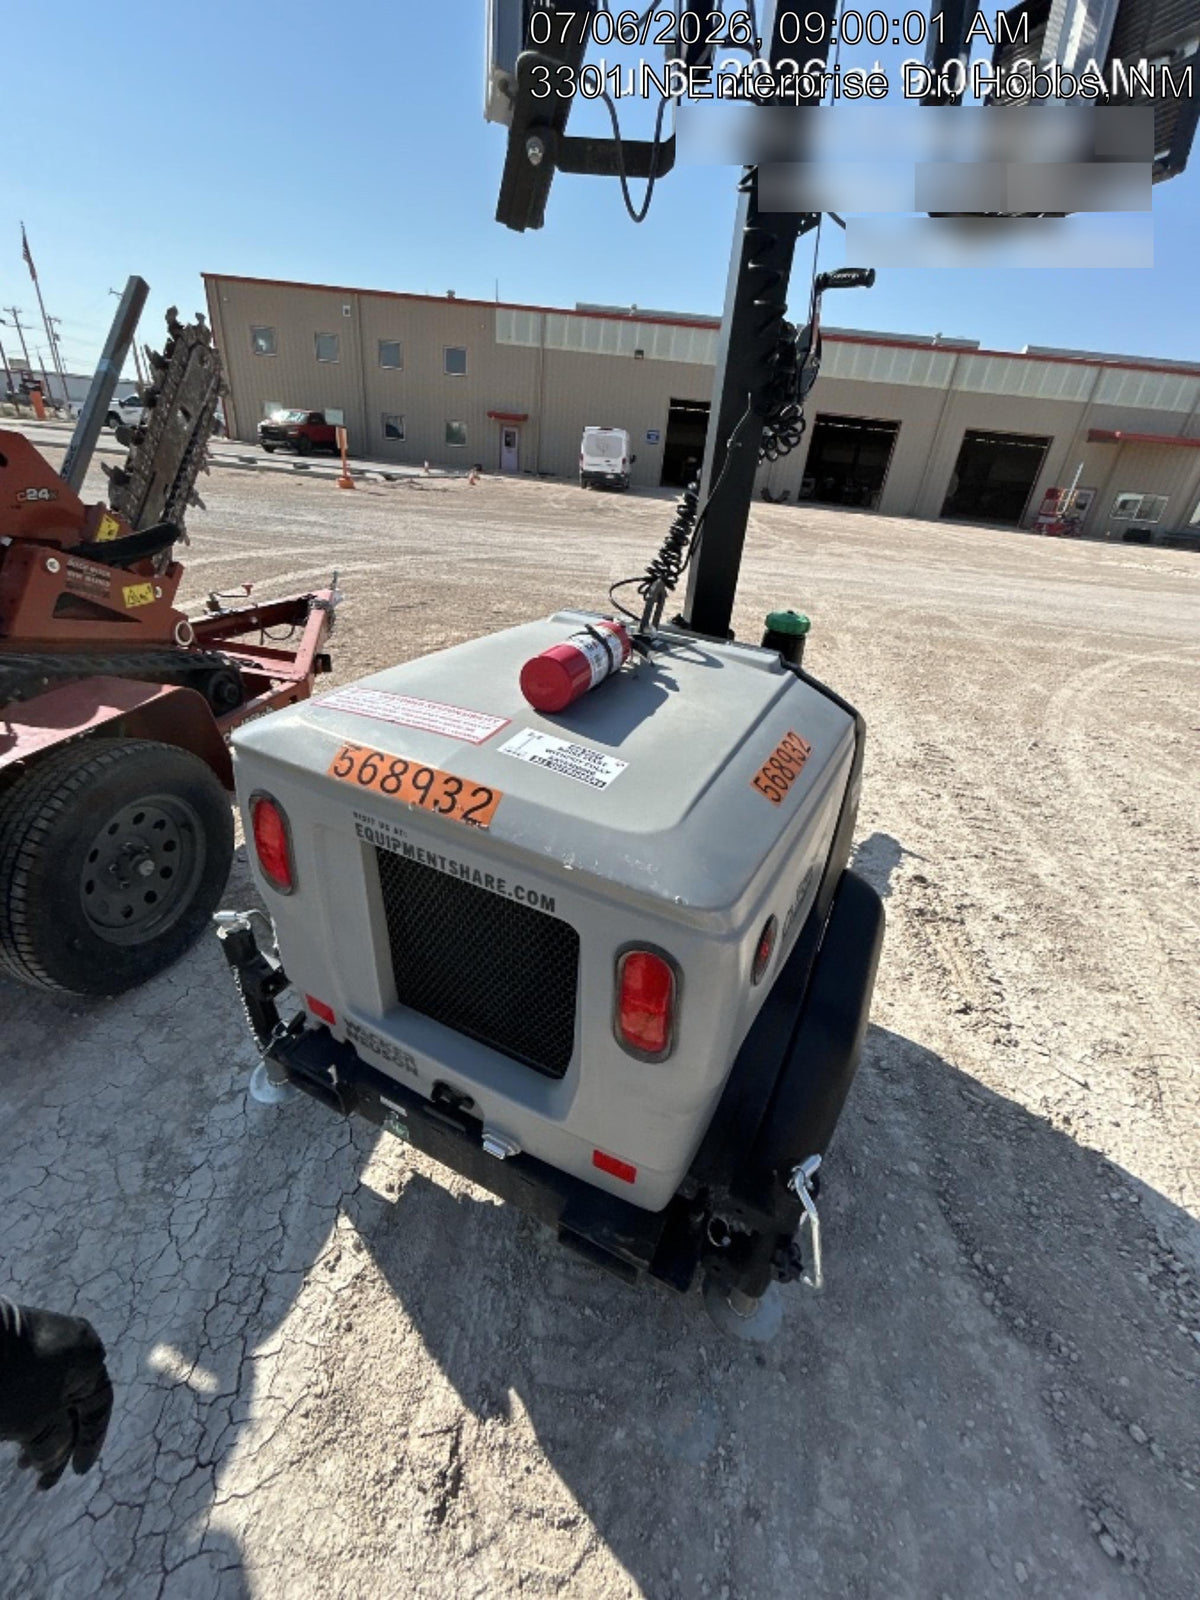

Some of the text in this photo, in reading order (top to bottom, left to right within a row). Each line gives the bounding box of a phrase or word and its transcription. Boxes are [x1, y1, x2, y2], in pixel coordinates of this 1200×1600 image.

[332, 745, 494, 828] 568932
[752, 731, 812, 804] 568932
[354, 821, 556, 914] EQUIPMENTSHARE.COM
